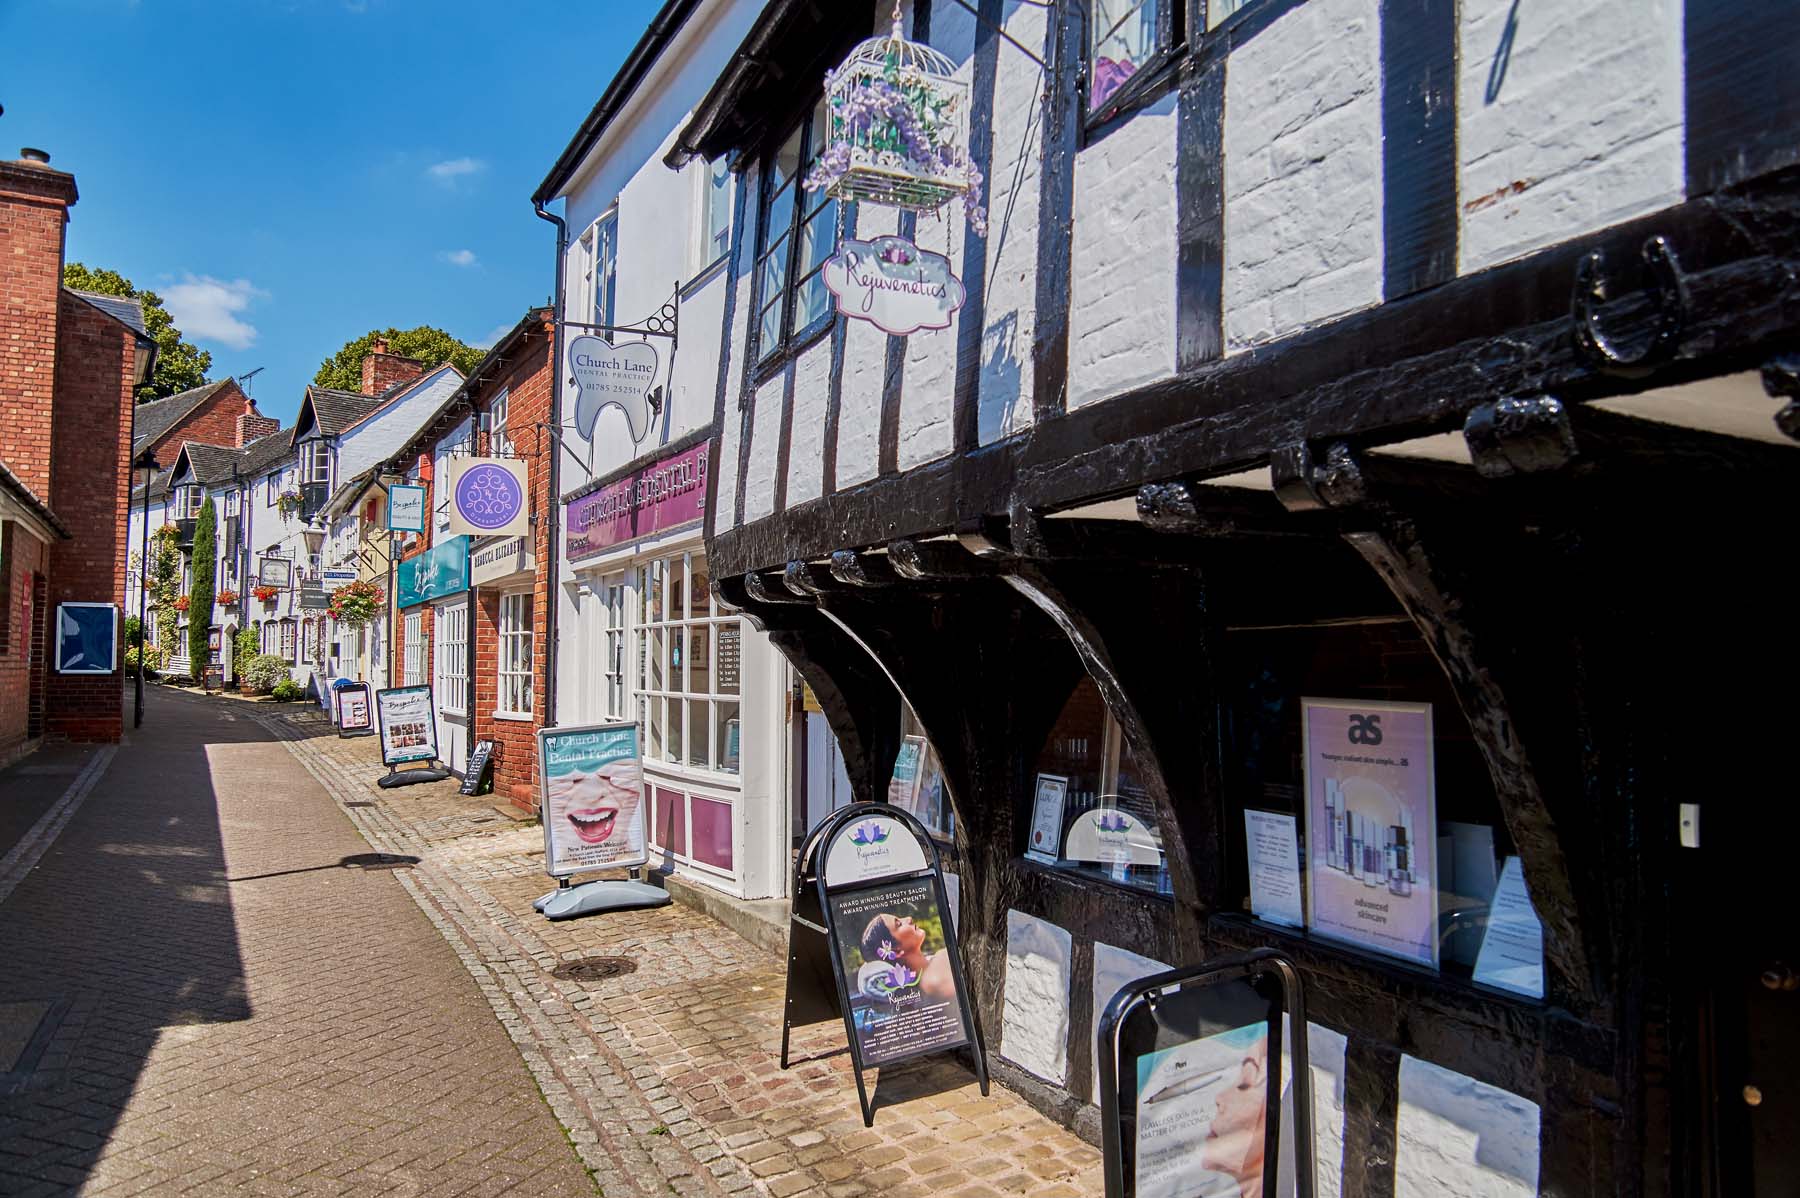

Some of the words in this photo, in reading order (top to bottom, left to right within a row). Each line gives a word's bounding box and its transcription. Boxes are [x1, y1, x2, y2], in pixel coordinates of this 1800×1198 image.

[846, 251, 946, 313] Rejuvenetics
[576, 354, 620, 369] Church
[624, 359, 653, 373] Lane
[577, 368, 608, 377] DENTAL
[612, 372, 651, 381] PRACTICE
[586, 383, 610, 392] 01785
[613, 385, 641, 395] 252514
[475, 548, 494, 568] REBECCA
[1348, 713, 1382, 745] as
[560, 734, 598, 746] Church
[603, 732, 630, 743] Lane
[550, 751, 585, 764] Dental
[589, 748, 632, 759] Practice
[839, 900, 859, 908] AWARD
[860, 895, 885, 904] WINNING
[885, 891, 907, 899] BEAUTY
[908, 887, 927, 895] SALON
[843, 906, 863, 915] AWARD
[864, 901, 889, 910] WINNING
[889, 894, 926, 905] TREATMENTS
